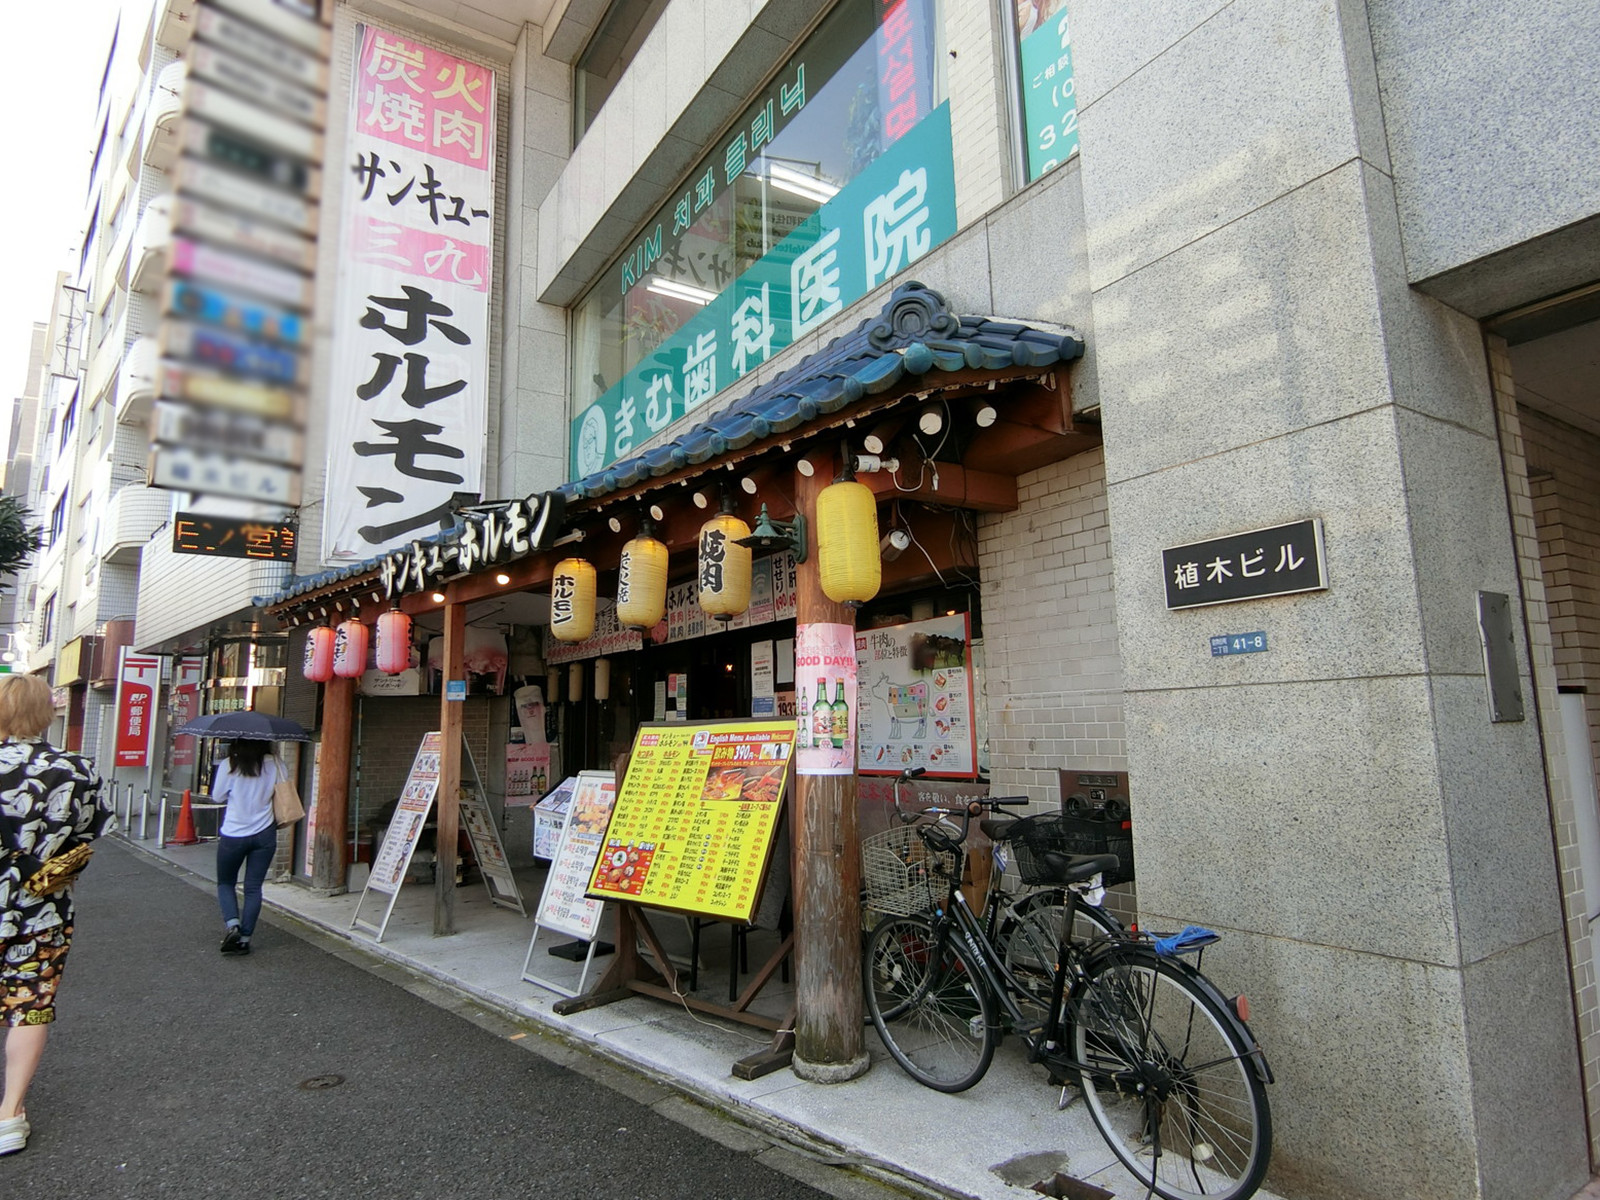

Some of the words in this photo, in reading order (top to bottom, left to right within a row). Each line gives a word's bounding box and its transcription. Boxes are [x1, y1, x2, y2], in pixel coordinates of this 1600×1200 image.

[366, 36, 485, 114] 炭火
[364, 83, 484, 159] 焼肉
[351, 151, 489, 226] サンキュー
[621, 224, 662, 295] KIM
[673, 165, 716, 238] 치과
[724, 63, 807, 181] 클리닉
[355, 225, 483, 286] 三九
[614, 166, 931, 458] きむ歯科医院
[352, 284, 472, 545] ホルモン
[699, 529, 726, 593] 焼肉
[773, 556, 784, 594] せせり
[1173, 543, 1306, 590] 植木ビル
[553, 574, 575, 625] ホルモン
[668, 584, 699, 611] ホルモ
[1232, 635, 1263, 650] 41-8
[128, 705, 143, 736] 郵便局
[710, 734, 728, 744] English
[729, 733, 745, 742] Menu
[745, 733, 771, 742] Available
